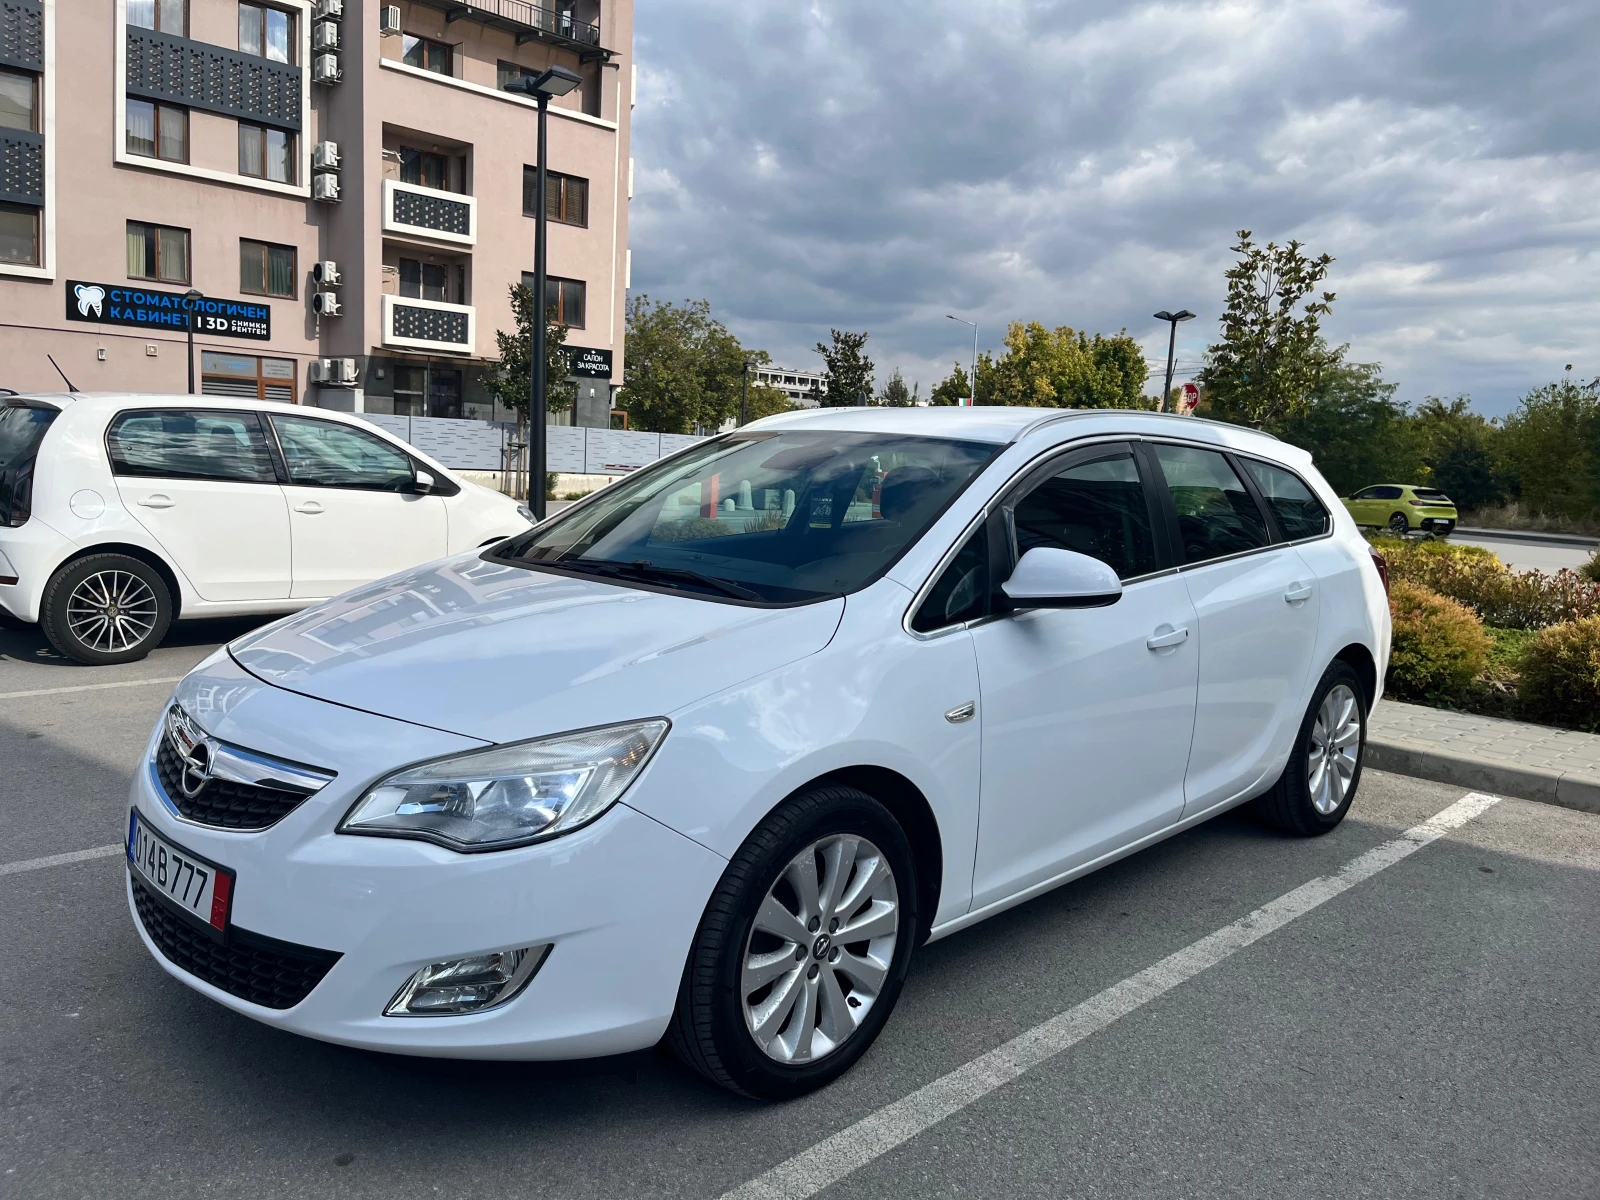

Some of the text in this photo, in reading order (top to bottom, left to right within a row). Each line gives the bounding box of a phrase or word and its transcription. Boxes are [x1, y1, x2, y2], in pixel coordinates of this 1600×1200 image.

[110, 289, 267, 319] СТОМАТОЛОГИЧЕН
[110, 306, 189, 326] КАБИНЕТ
[206, 316, 228, 330] 3D
[231, 319, 267, 329] СНИМКИ
[231, 326, 267, 335] РЕНТГЕН
[583, 354, 603, 362] САЛОН
[585, 362, 609, 371] КРАСОТА
